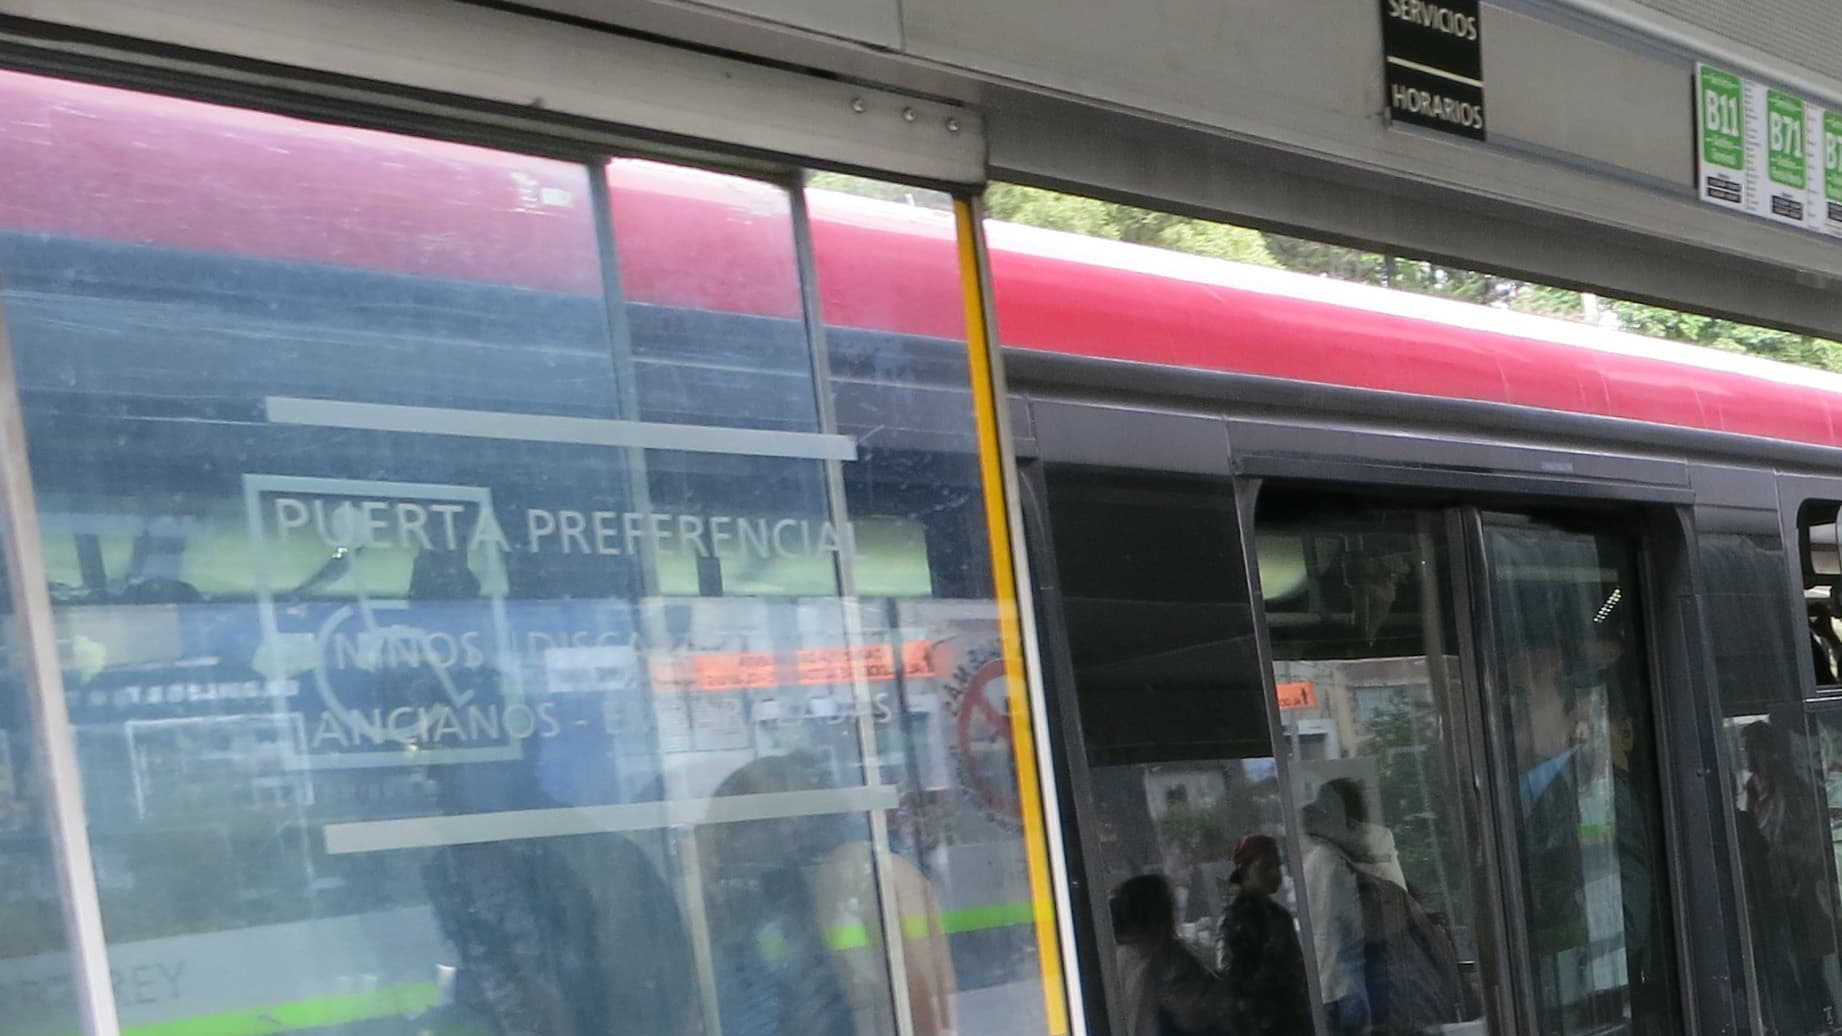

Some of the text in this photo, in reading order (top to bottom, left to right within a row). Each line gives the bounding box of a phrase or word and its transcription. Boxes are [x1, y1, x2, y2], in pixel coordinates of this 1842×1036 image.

[1391, 83, 1483, 130] HORARIOS
[1704, 88, 1741, 138] B11
[1769, 110, 1804, 159] B71
[272, 497, 868, 561] PUERTA PREFERENCIAL
